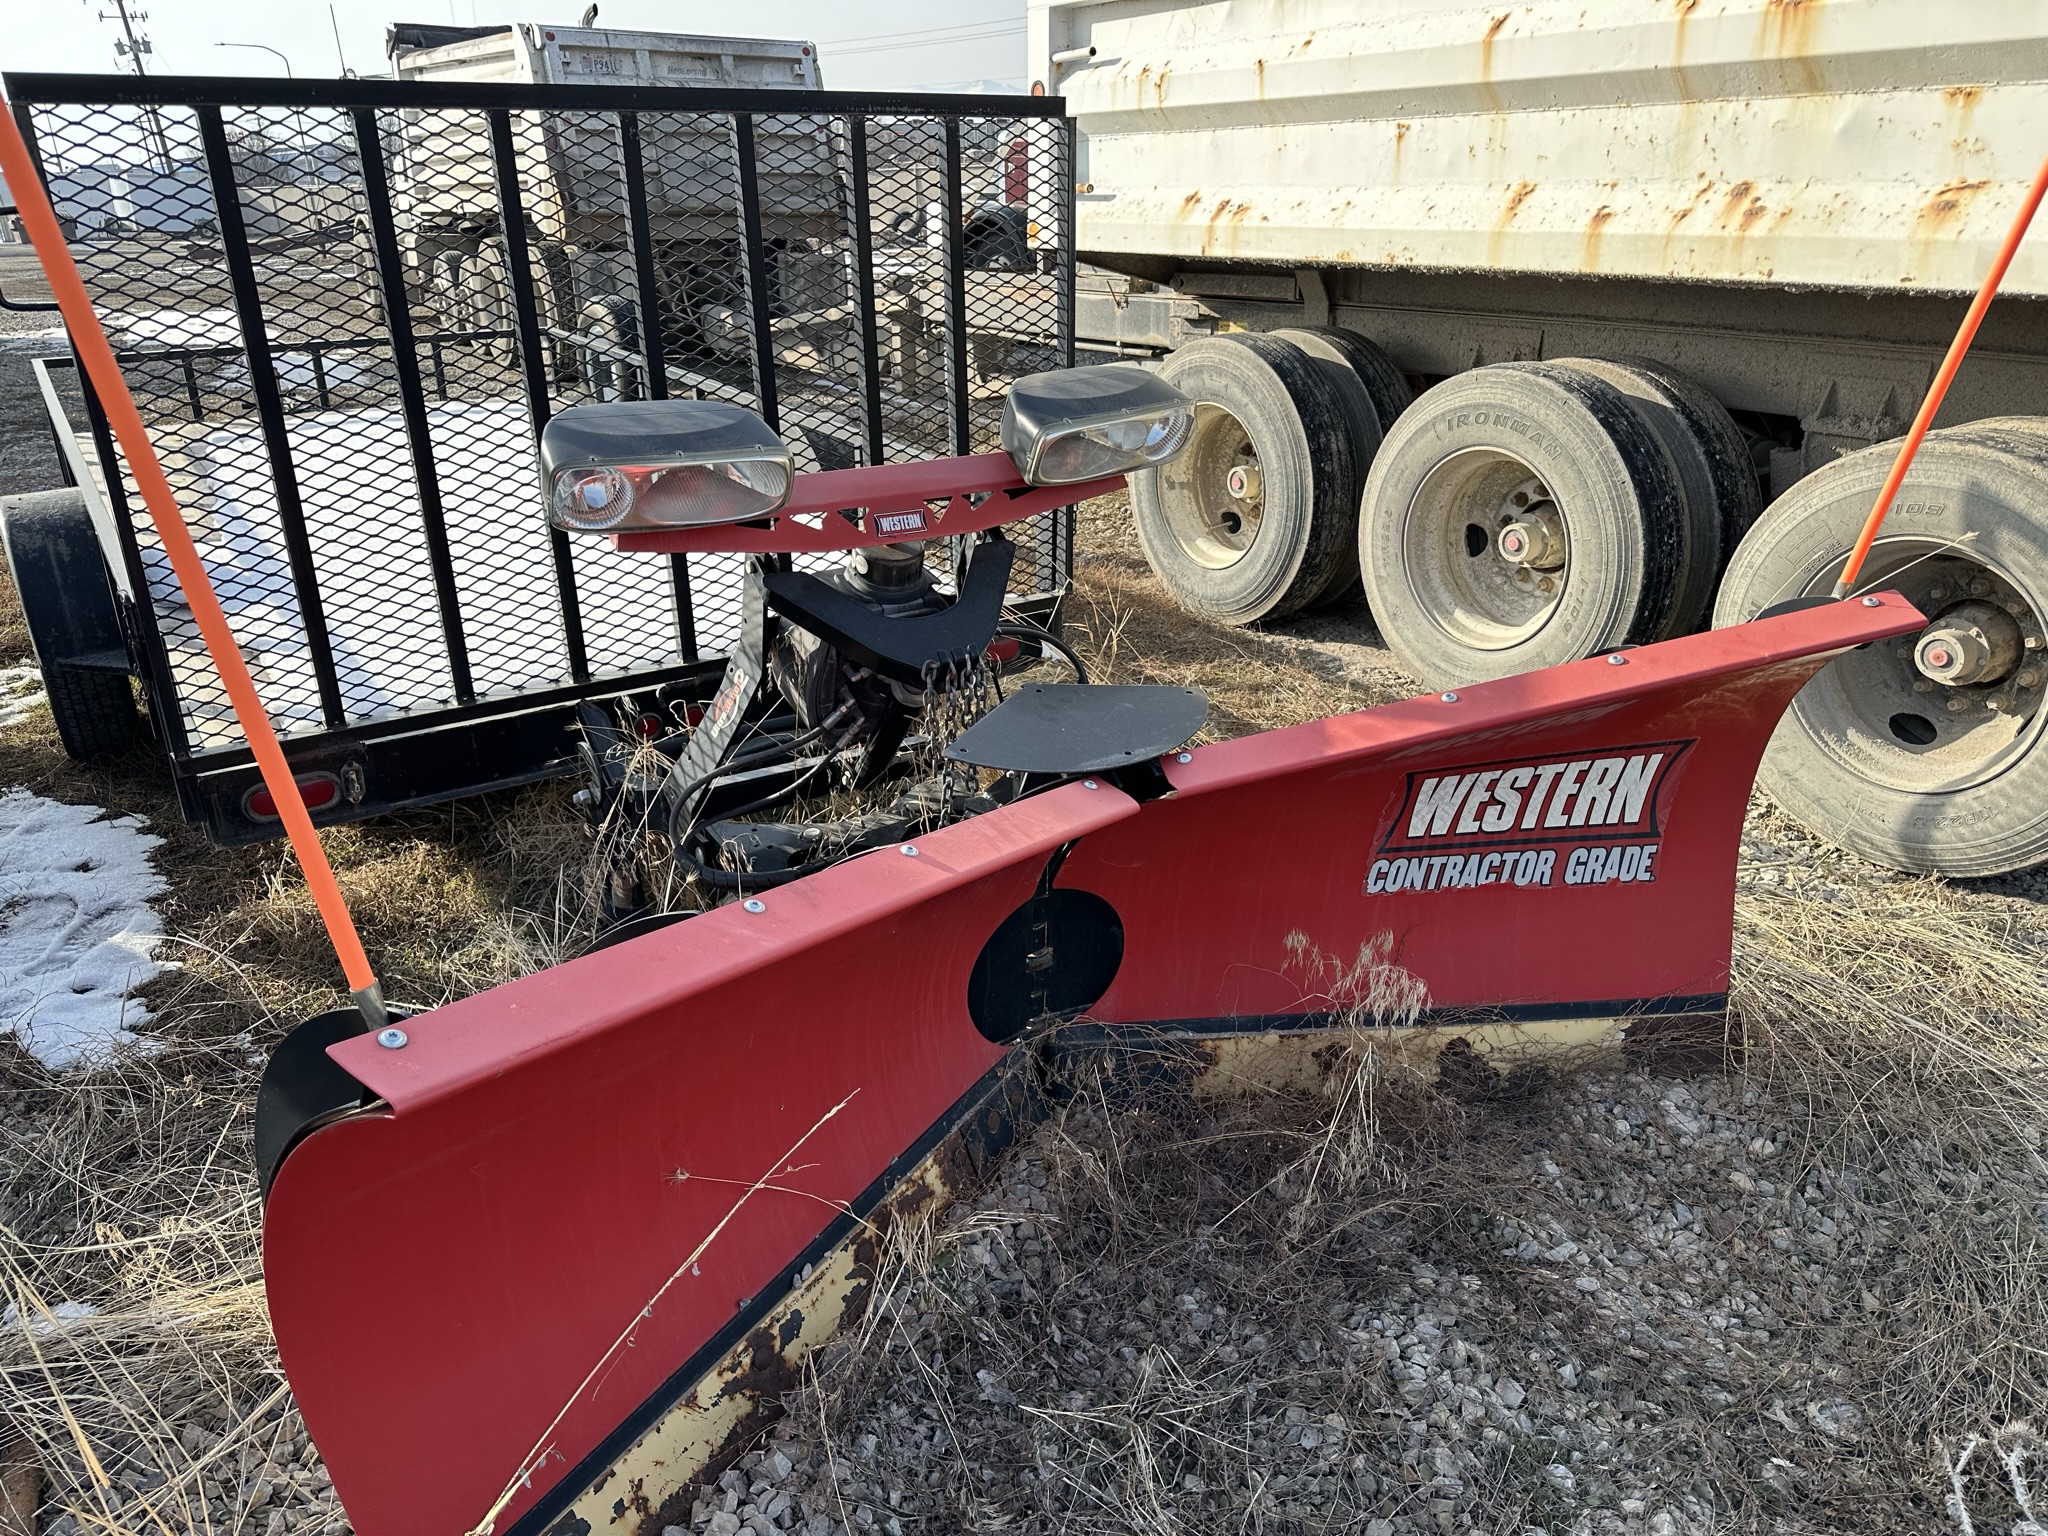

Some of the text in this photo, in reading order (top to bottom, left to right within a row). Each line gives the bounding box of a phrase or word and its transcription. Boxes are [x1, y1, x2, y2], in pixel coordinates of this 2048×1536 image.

[1446, 411, 1562, 460] IRONMAN
[880, 514, 922, 532] WESTERN
[1407, 752, 1664, 838] WESTERN
[1912, 805, 2000, 830] 11R22.5
[1366, 845, 1659, 894] CONTRACTOR GRADE
